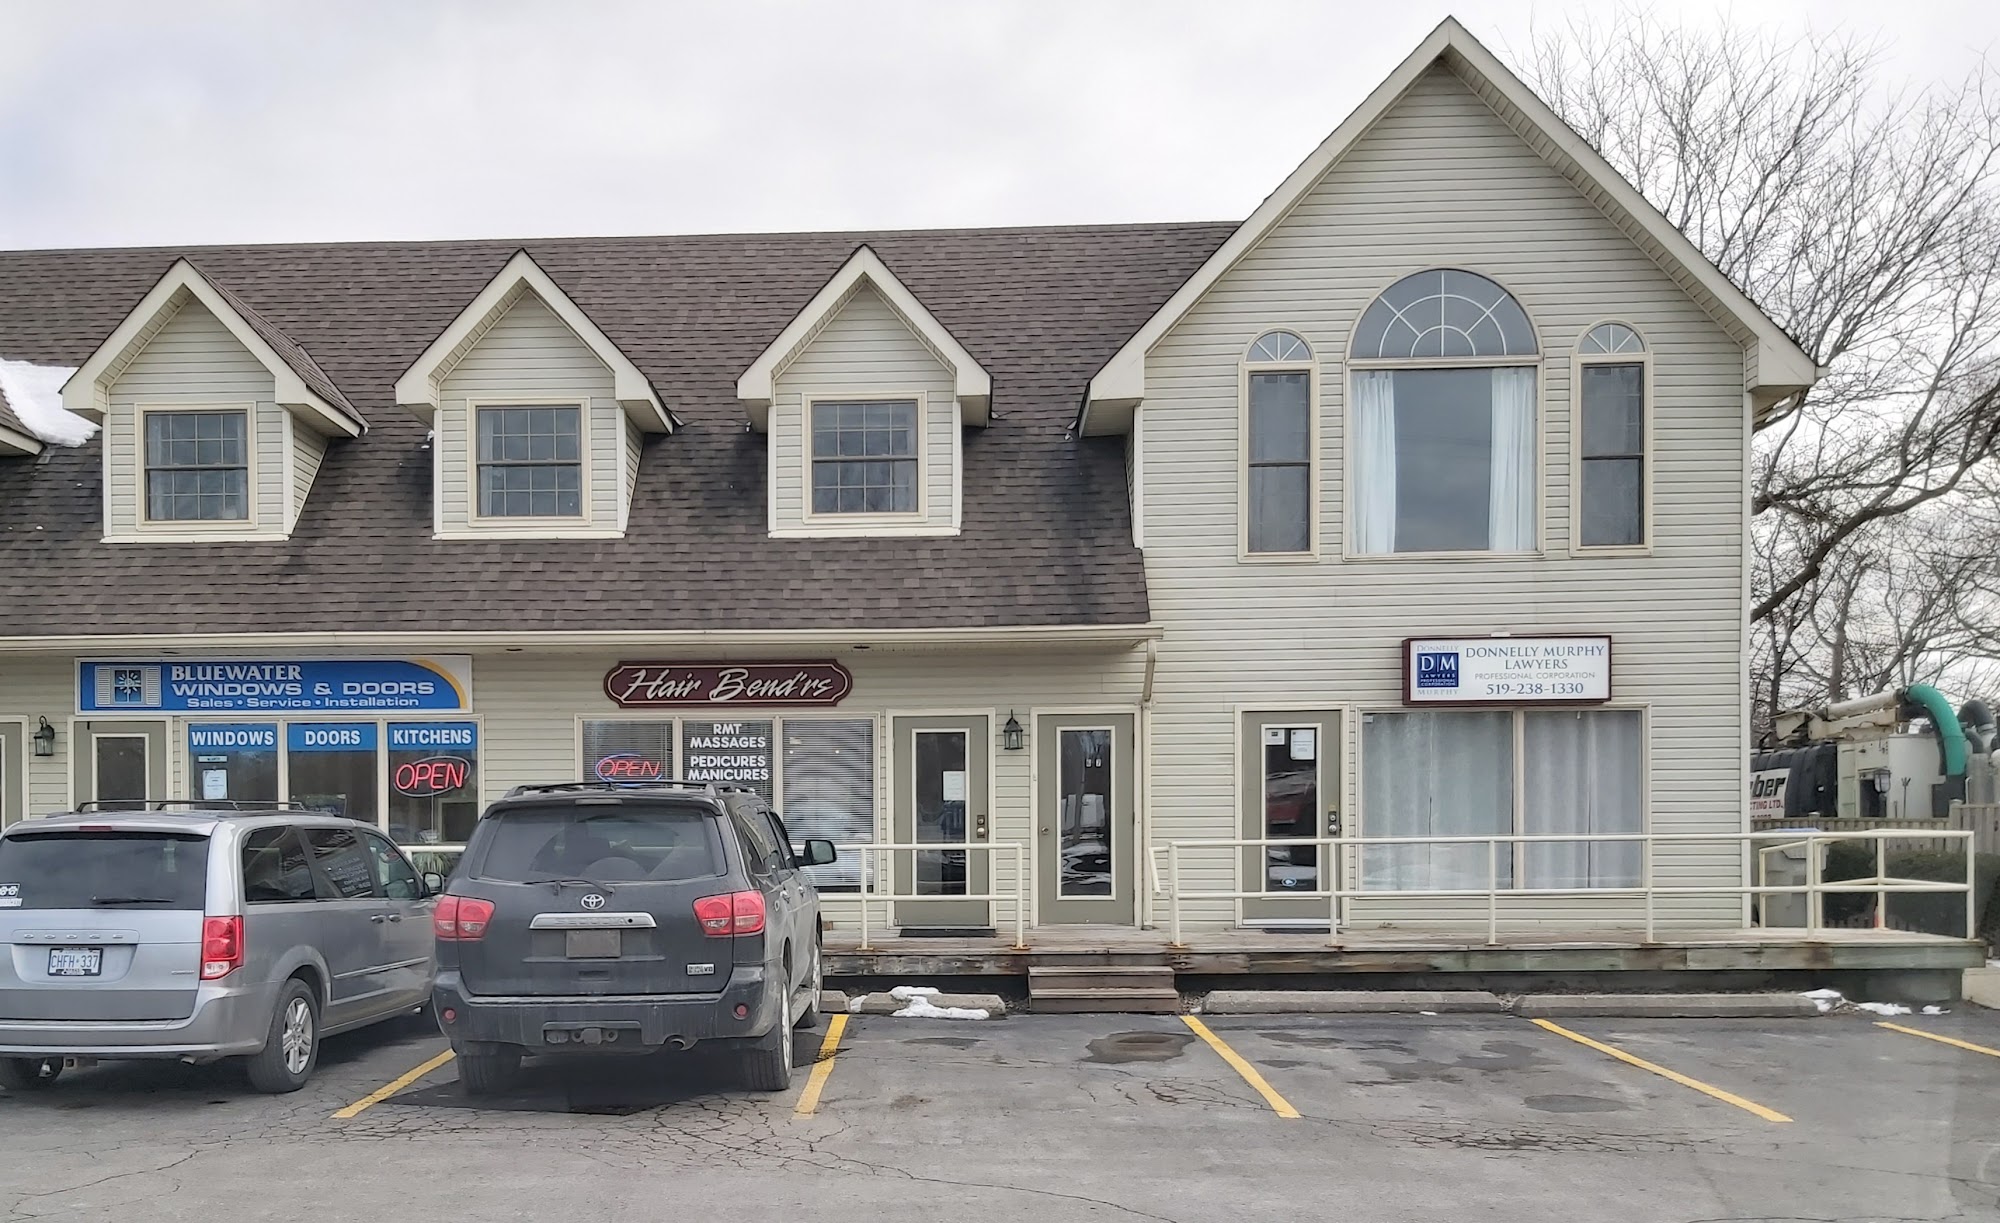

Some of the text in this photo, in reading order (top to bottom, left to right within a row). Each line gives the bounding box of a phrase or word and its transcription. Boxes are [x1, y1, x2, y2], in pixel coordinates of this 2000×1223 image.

[1465, 645, 1605, 658] DONNELLY MURPHY
[1505, 659, 1568, 670] LAWYERS
[171, 665, 303, 681] BLUEWATER
[1475, 671, 1595, 680] PROFESSIONAL CORPORATION
[171, 682, 435, 696] WINDOWS & DOORS
[621, 667, 835, 702] Hair Bend'rs
[1486, 682, 1584, 695] 519-238-1330
[187, 697, 419, 708] Sales Service Installation
[713, 723, 742, 735] RMT
[191, 731, 275, 746] WINDOWS
[305, 730, 361, 745] DOORS
[393, 729, 472, 745] KITCHENS
[690, 736, 766, 749] MASSAGES
[599, 759, 661, 777] OPEN
[690, 755, 766, 768] PEDICURES
[395, 763, 465, 790] OPEN
[688, 768, 769, 781] MANICURES
[1750, 775, 1786, 798] ber
[51, 954, 99, 968] CHFH 337
